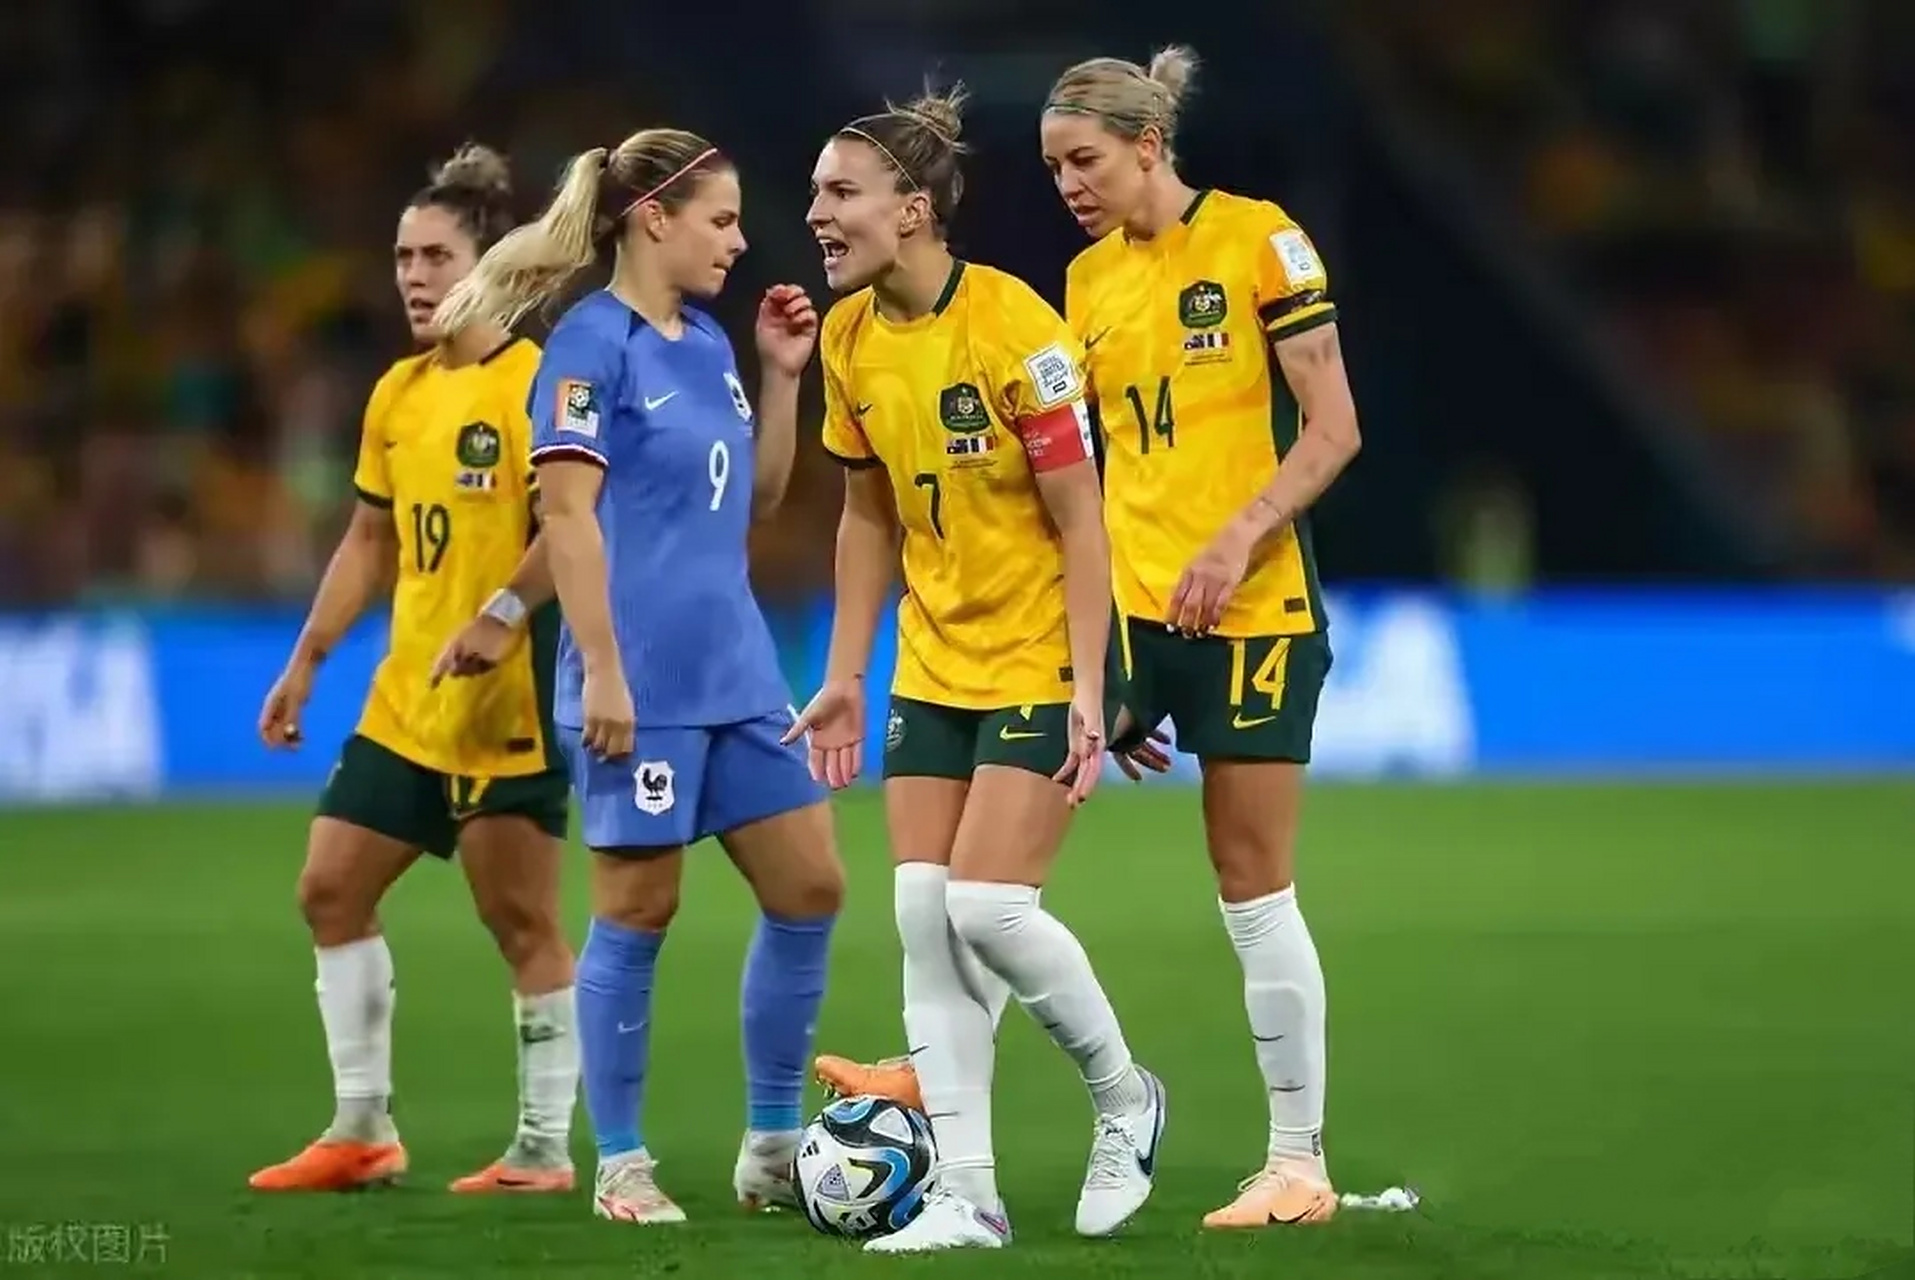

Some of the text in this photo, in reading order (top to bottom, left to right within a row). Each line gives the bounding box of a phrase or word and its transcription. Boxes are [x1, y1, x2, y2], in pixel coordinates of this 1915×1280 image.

[1126, 376, 1174, 454] 14
[709, 440, 728, 511] 9
[915, 474, 944, 538] 7
[413, 504, 450, 572] 19
[1230, 638, 1290, 709] 14
